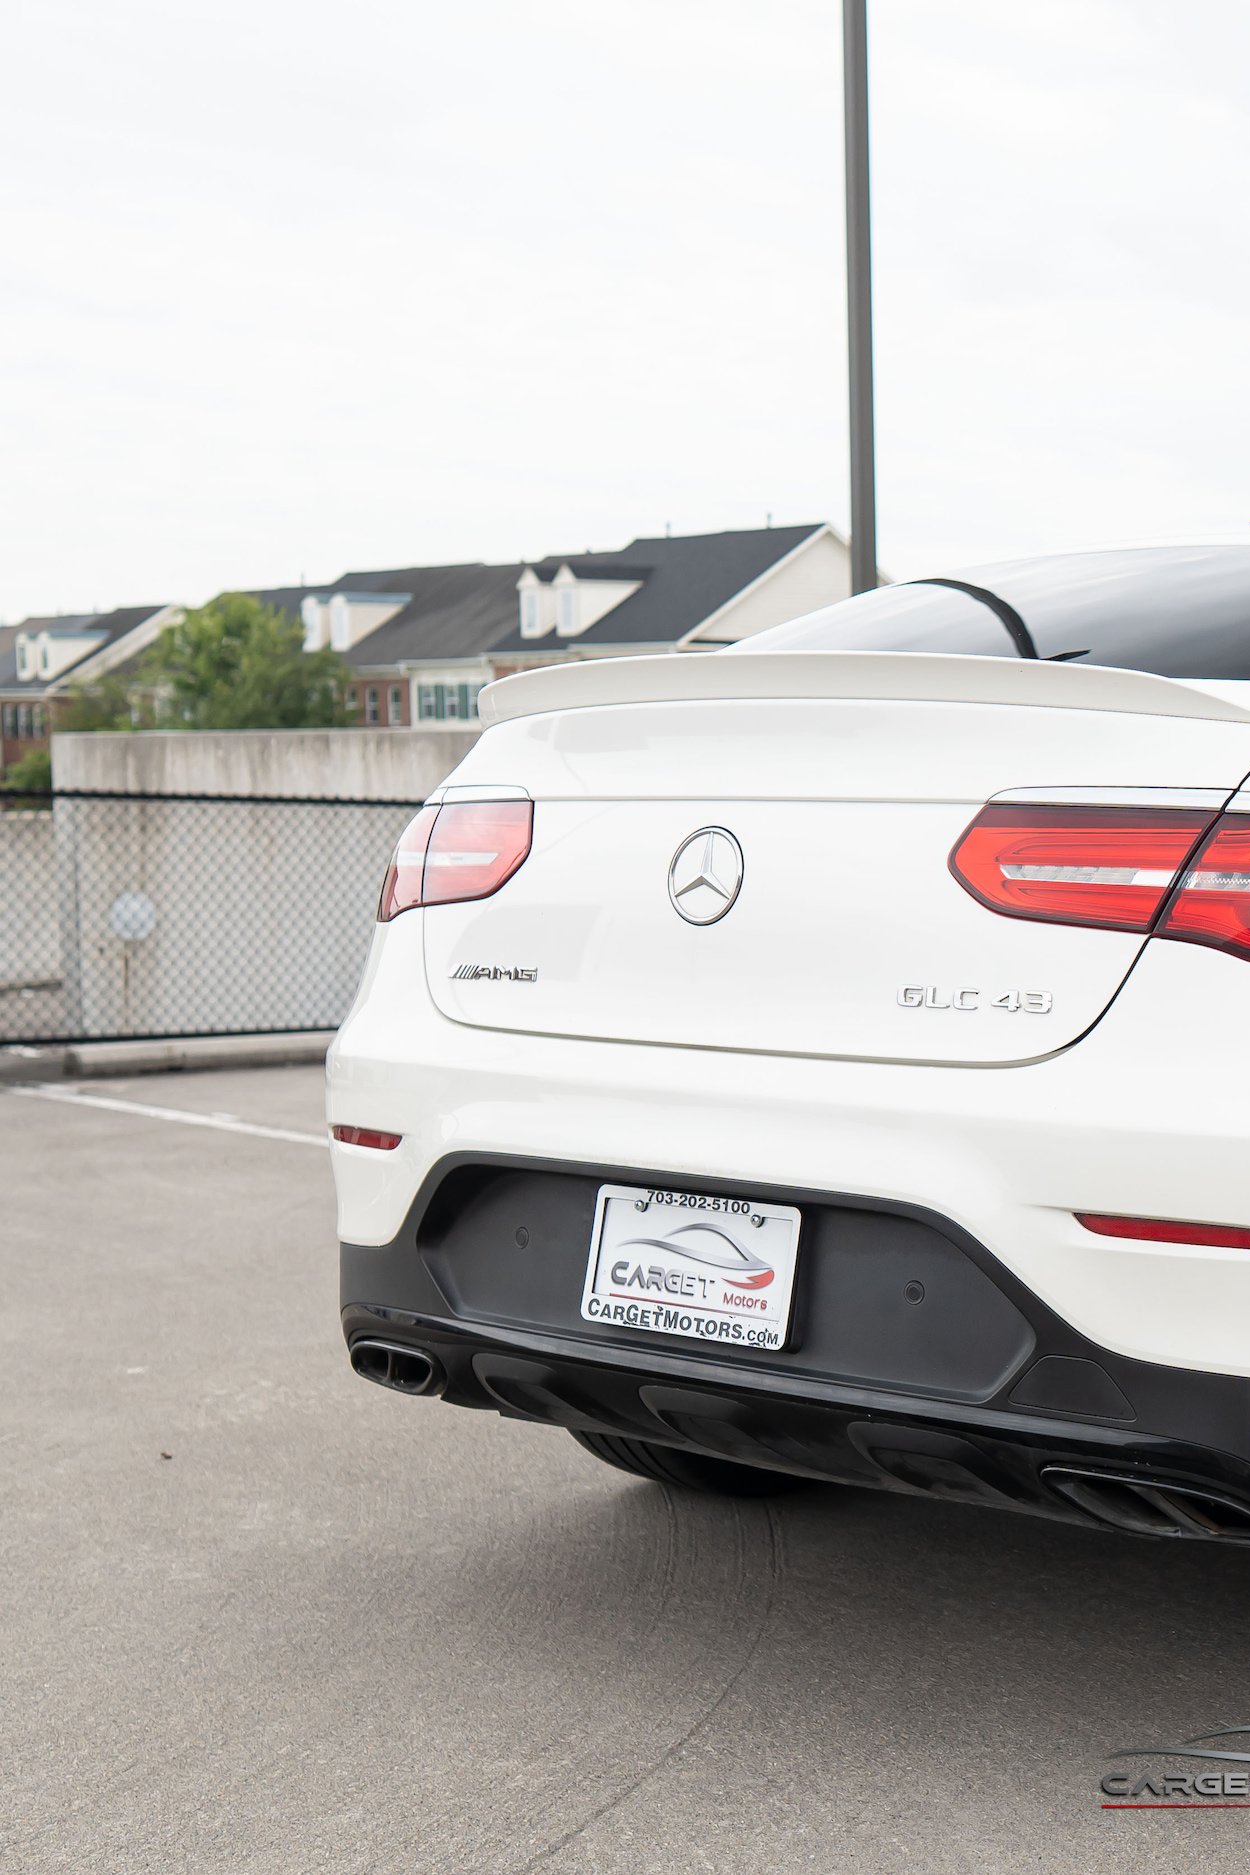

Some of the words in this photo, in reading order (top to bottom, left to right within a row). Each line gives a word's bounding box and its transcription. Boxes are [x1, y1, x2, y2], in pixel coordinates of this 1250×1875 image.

[473, 964, 538, 982] AMG
[896, 984, 980, 1011] GLC
[990, 988, 1053, 1014] 43
[647, 1190, 751, 1215] 703-202-5100
[610, 1261, 716, 1299] CARGET
[722, 1291, 768, 1311] Motors
